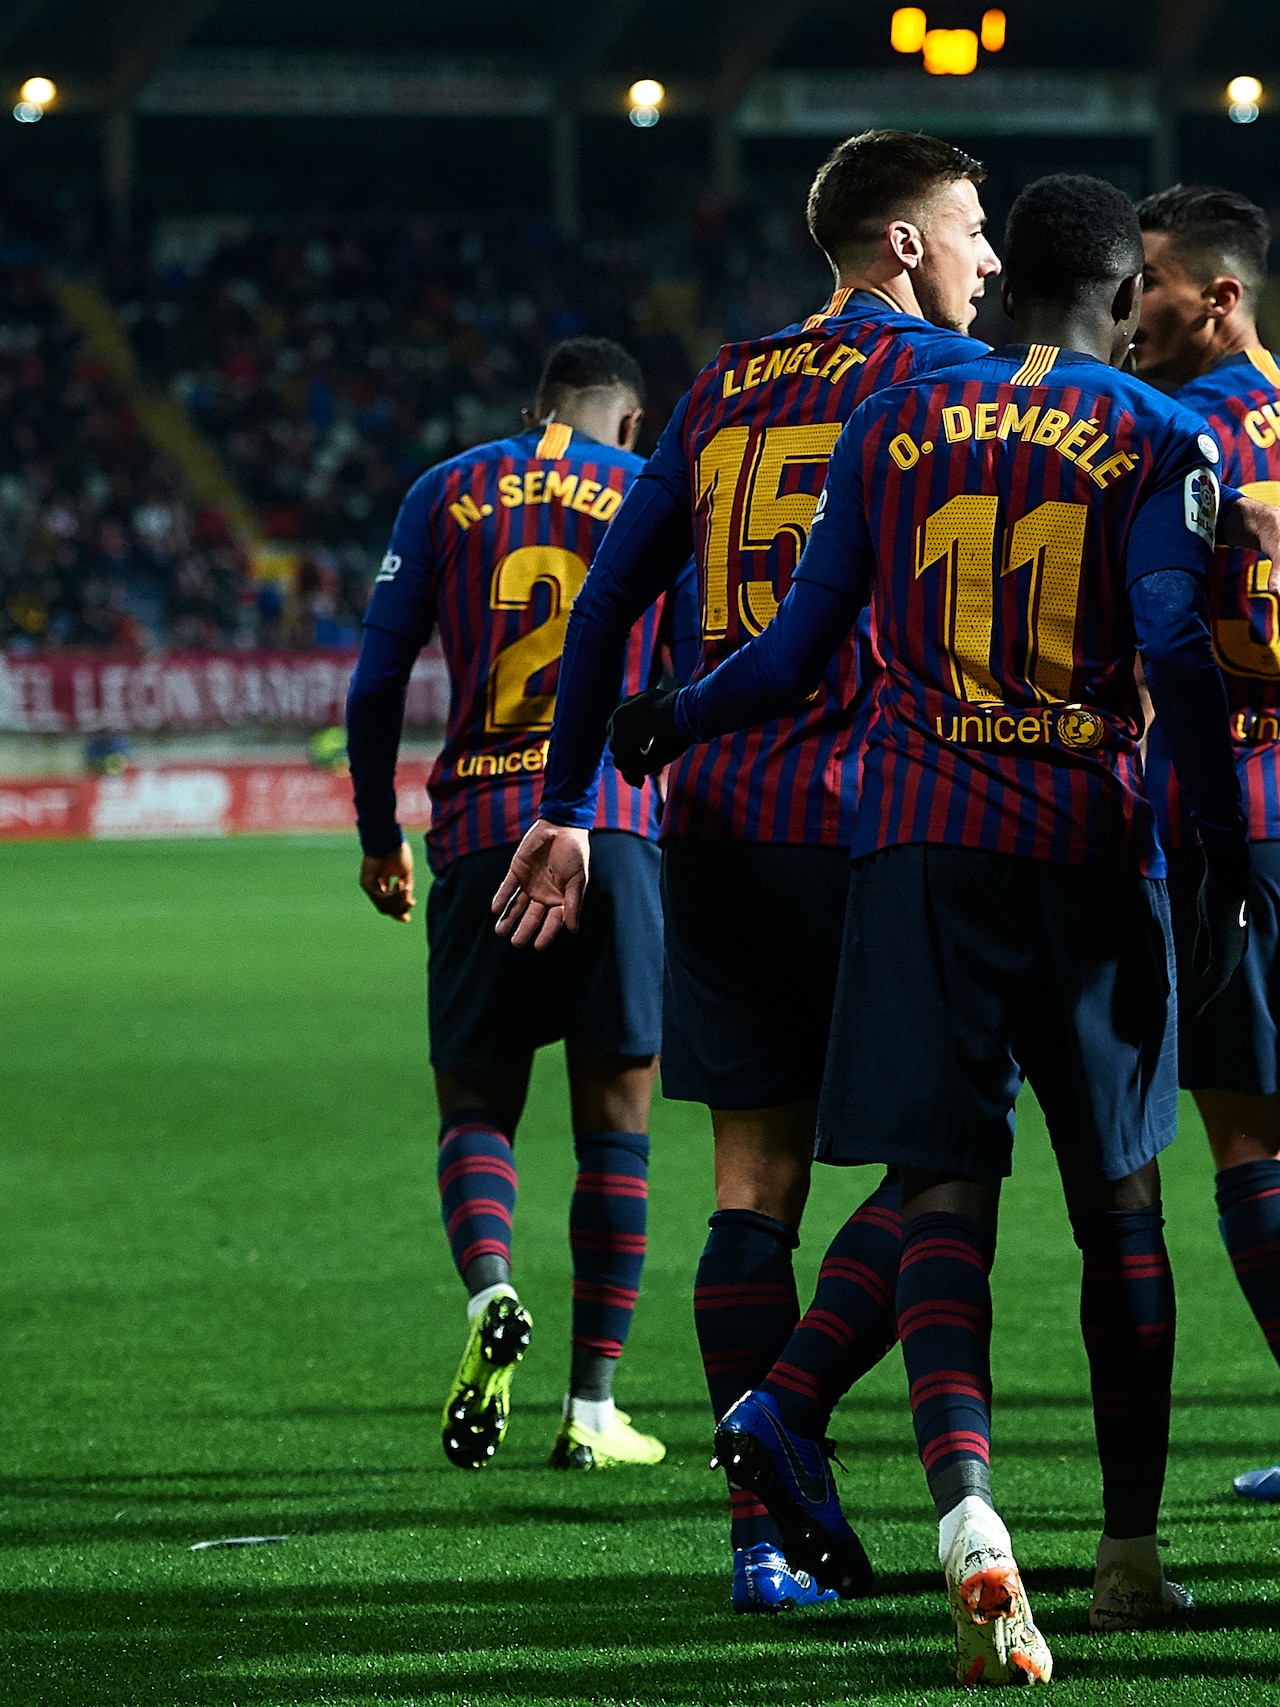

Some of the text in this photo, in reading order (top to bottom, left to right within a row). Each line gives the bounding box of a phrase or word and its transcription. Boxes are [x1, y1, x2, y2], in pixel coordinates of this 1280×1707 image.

[722, 342, 867, 399] LENGLET
[888, 432, 934, 470] O.
[941, 401, 1141, 490] DEMBÉLÉ
[449, 470, 624, 531] N. SEMED
[695, 422, 843, 640] 15
[484, 545, 591, 733] 2
[915, 494, 1088, 708] 11
[935, 709, 1053, 744] unicef
